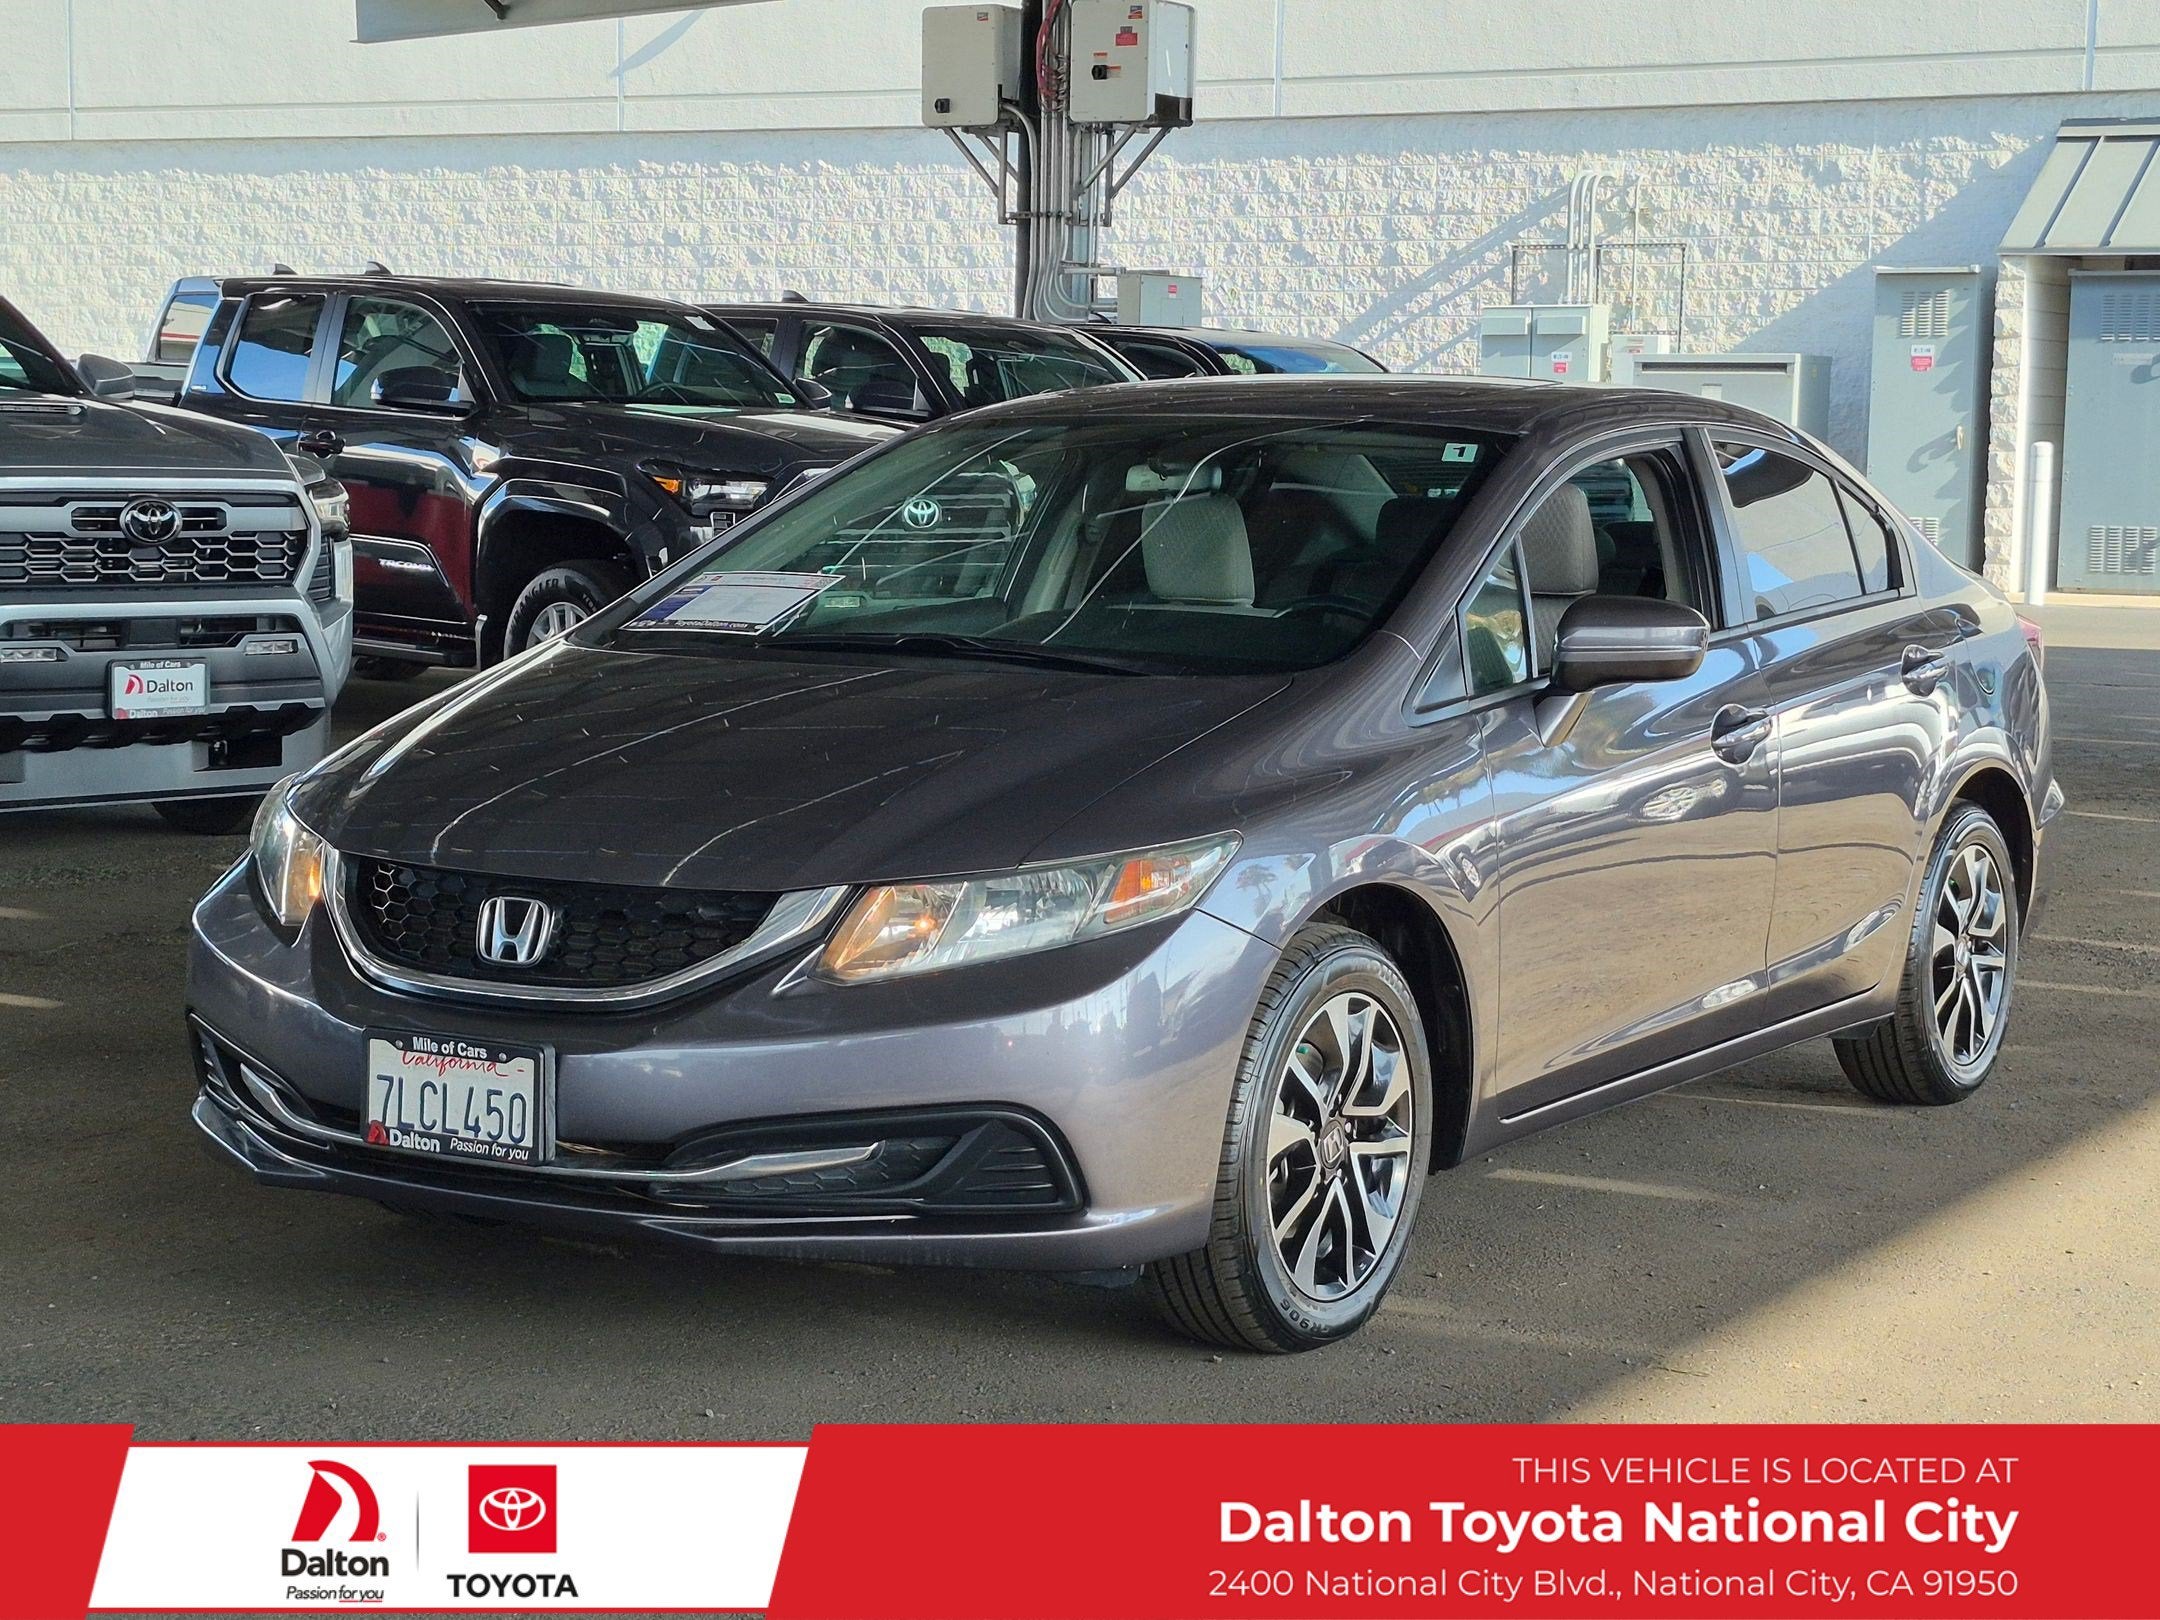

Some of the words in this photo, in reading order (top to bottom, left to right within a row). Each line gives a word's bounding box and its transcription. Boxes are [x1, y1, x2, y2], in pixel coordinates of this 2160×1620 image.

[1453, 446, 1467, 457] 1
[140, 661, 155, 669] Mile
[165, 660, 181, 668] Cars
[147, 679, 193, 693] Dalton
[412, 1036, 439, 1053] Mile
[441, 1040, 455, 1054] of
[457, 1042, 488, 1059] Cars
[376, 1074, 528, 1144] 7LCL450
[389, 1129, 441, 1153] Dalton
[449, 1137, 489, 1156] Passion
[491, 1144, 508, 1158] for
[508, 1147, 529, 1161] you
